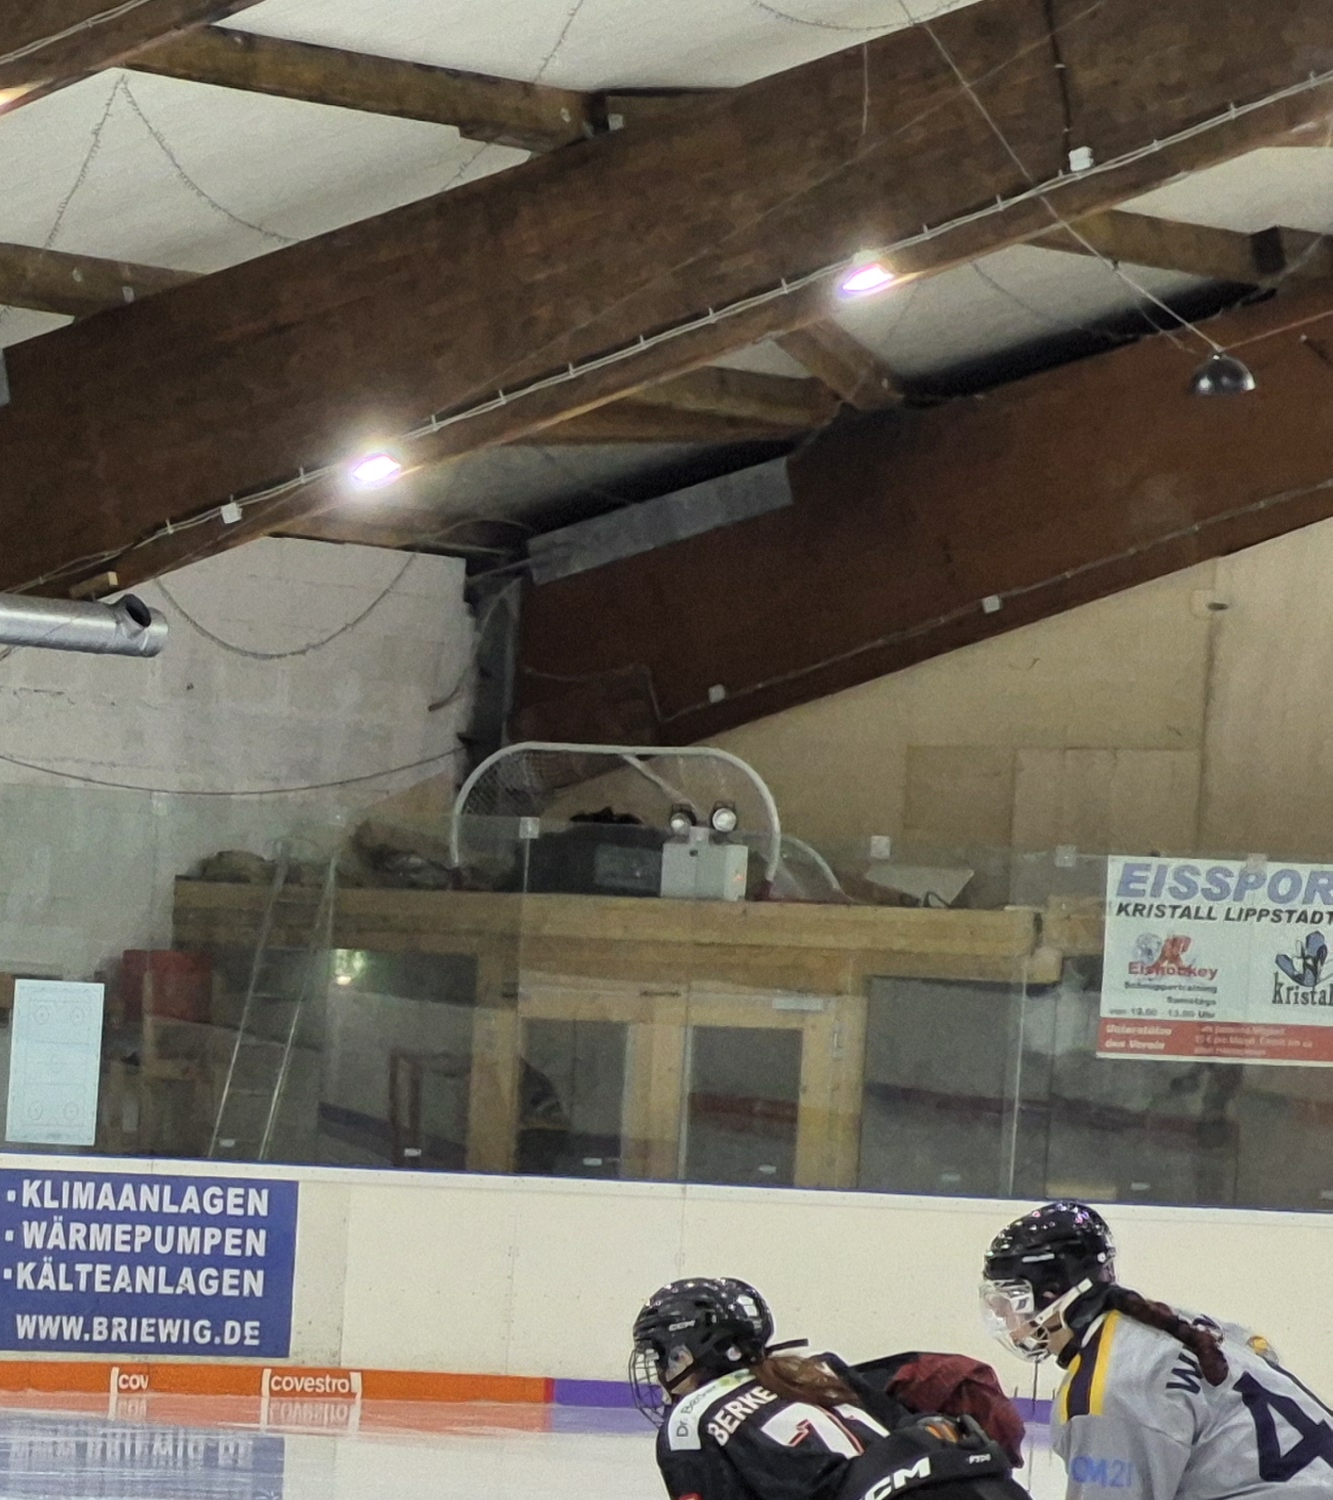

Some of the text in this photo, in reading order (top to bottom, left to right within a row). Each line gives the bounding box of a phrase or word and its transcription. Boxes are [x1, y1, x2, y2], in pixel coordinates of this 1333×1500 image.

[1115, 902, 1333, 925] KRISTALL LIPPSTADT
[22, 1179, 269, 1217] KLIMAANLAGEN
[22, 1215, 267, 1257] WÄRMEPUMPEN
[16, 1256, 265, 1298] KÄLTEANLAGEN
[16, 1314, 261, 1346] WWW.BRIEWIG.DE
[271, 1374, 351, 1395] covestro
